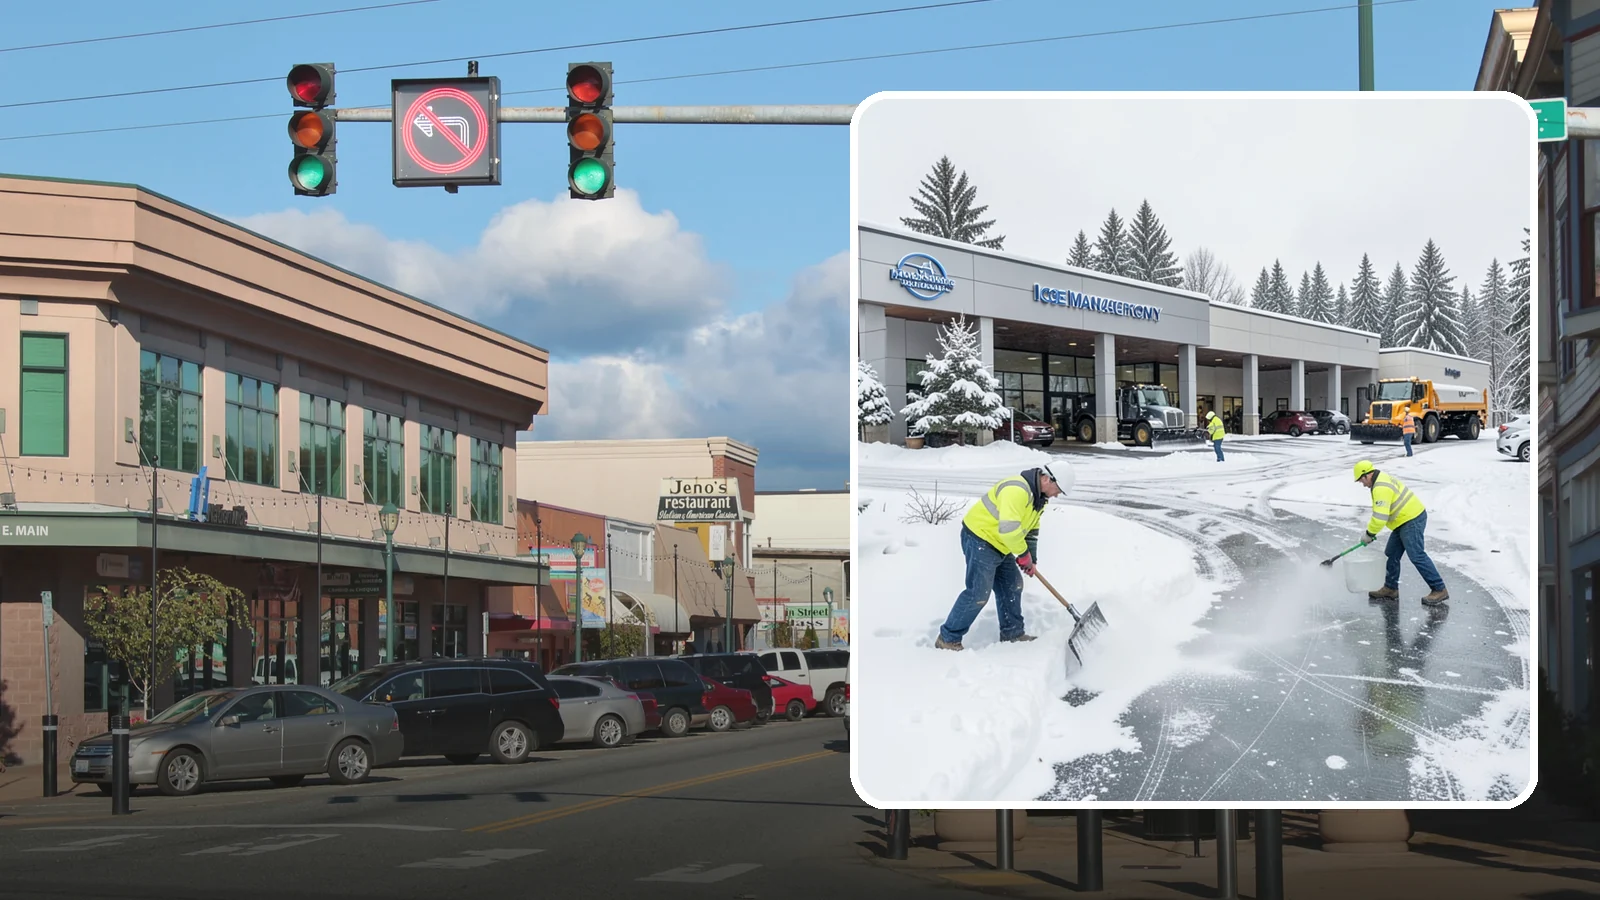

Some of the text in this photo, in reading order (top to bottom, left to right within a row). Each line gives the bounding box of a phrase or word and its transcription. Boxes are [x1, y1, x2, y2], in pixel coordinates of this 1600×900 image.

[670, 480, 728, 495] Jeno's
[665, 496, 731, 509] restaurant
[658, 509, 681, 520] Italian
[686, 509, 714, 519] American
[715, 509, 737, 519] Cuisine
[2, 525, 49, 536] E. MAIN
[797, 608, 829, 617] Street
